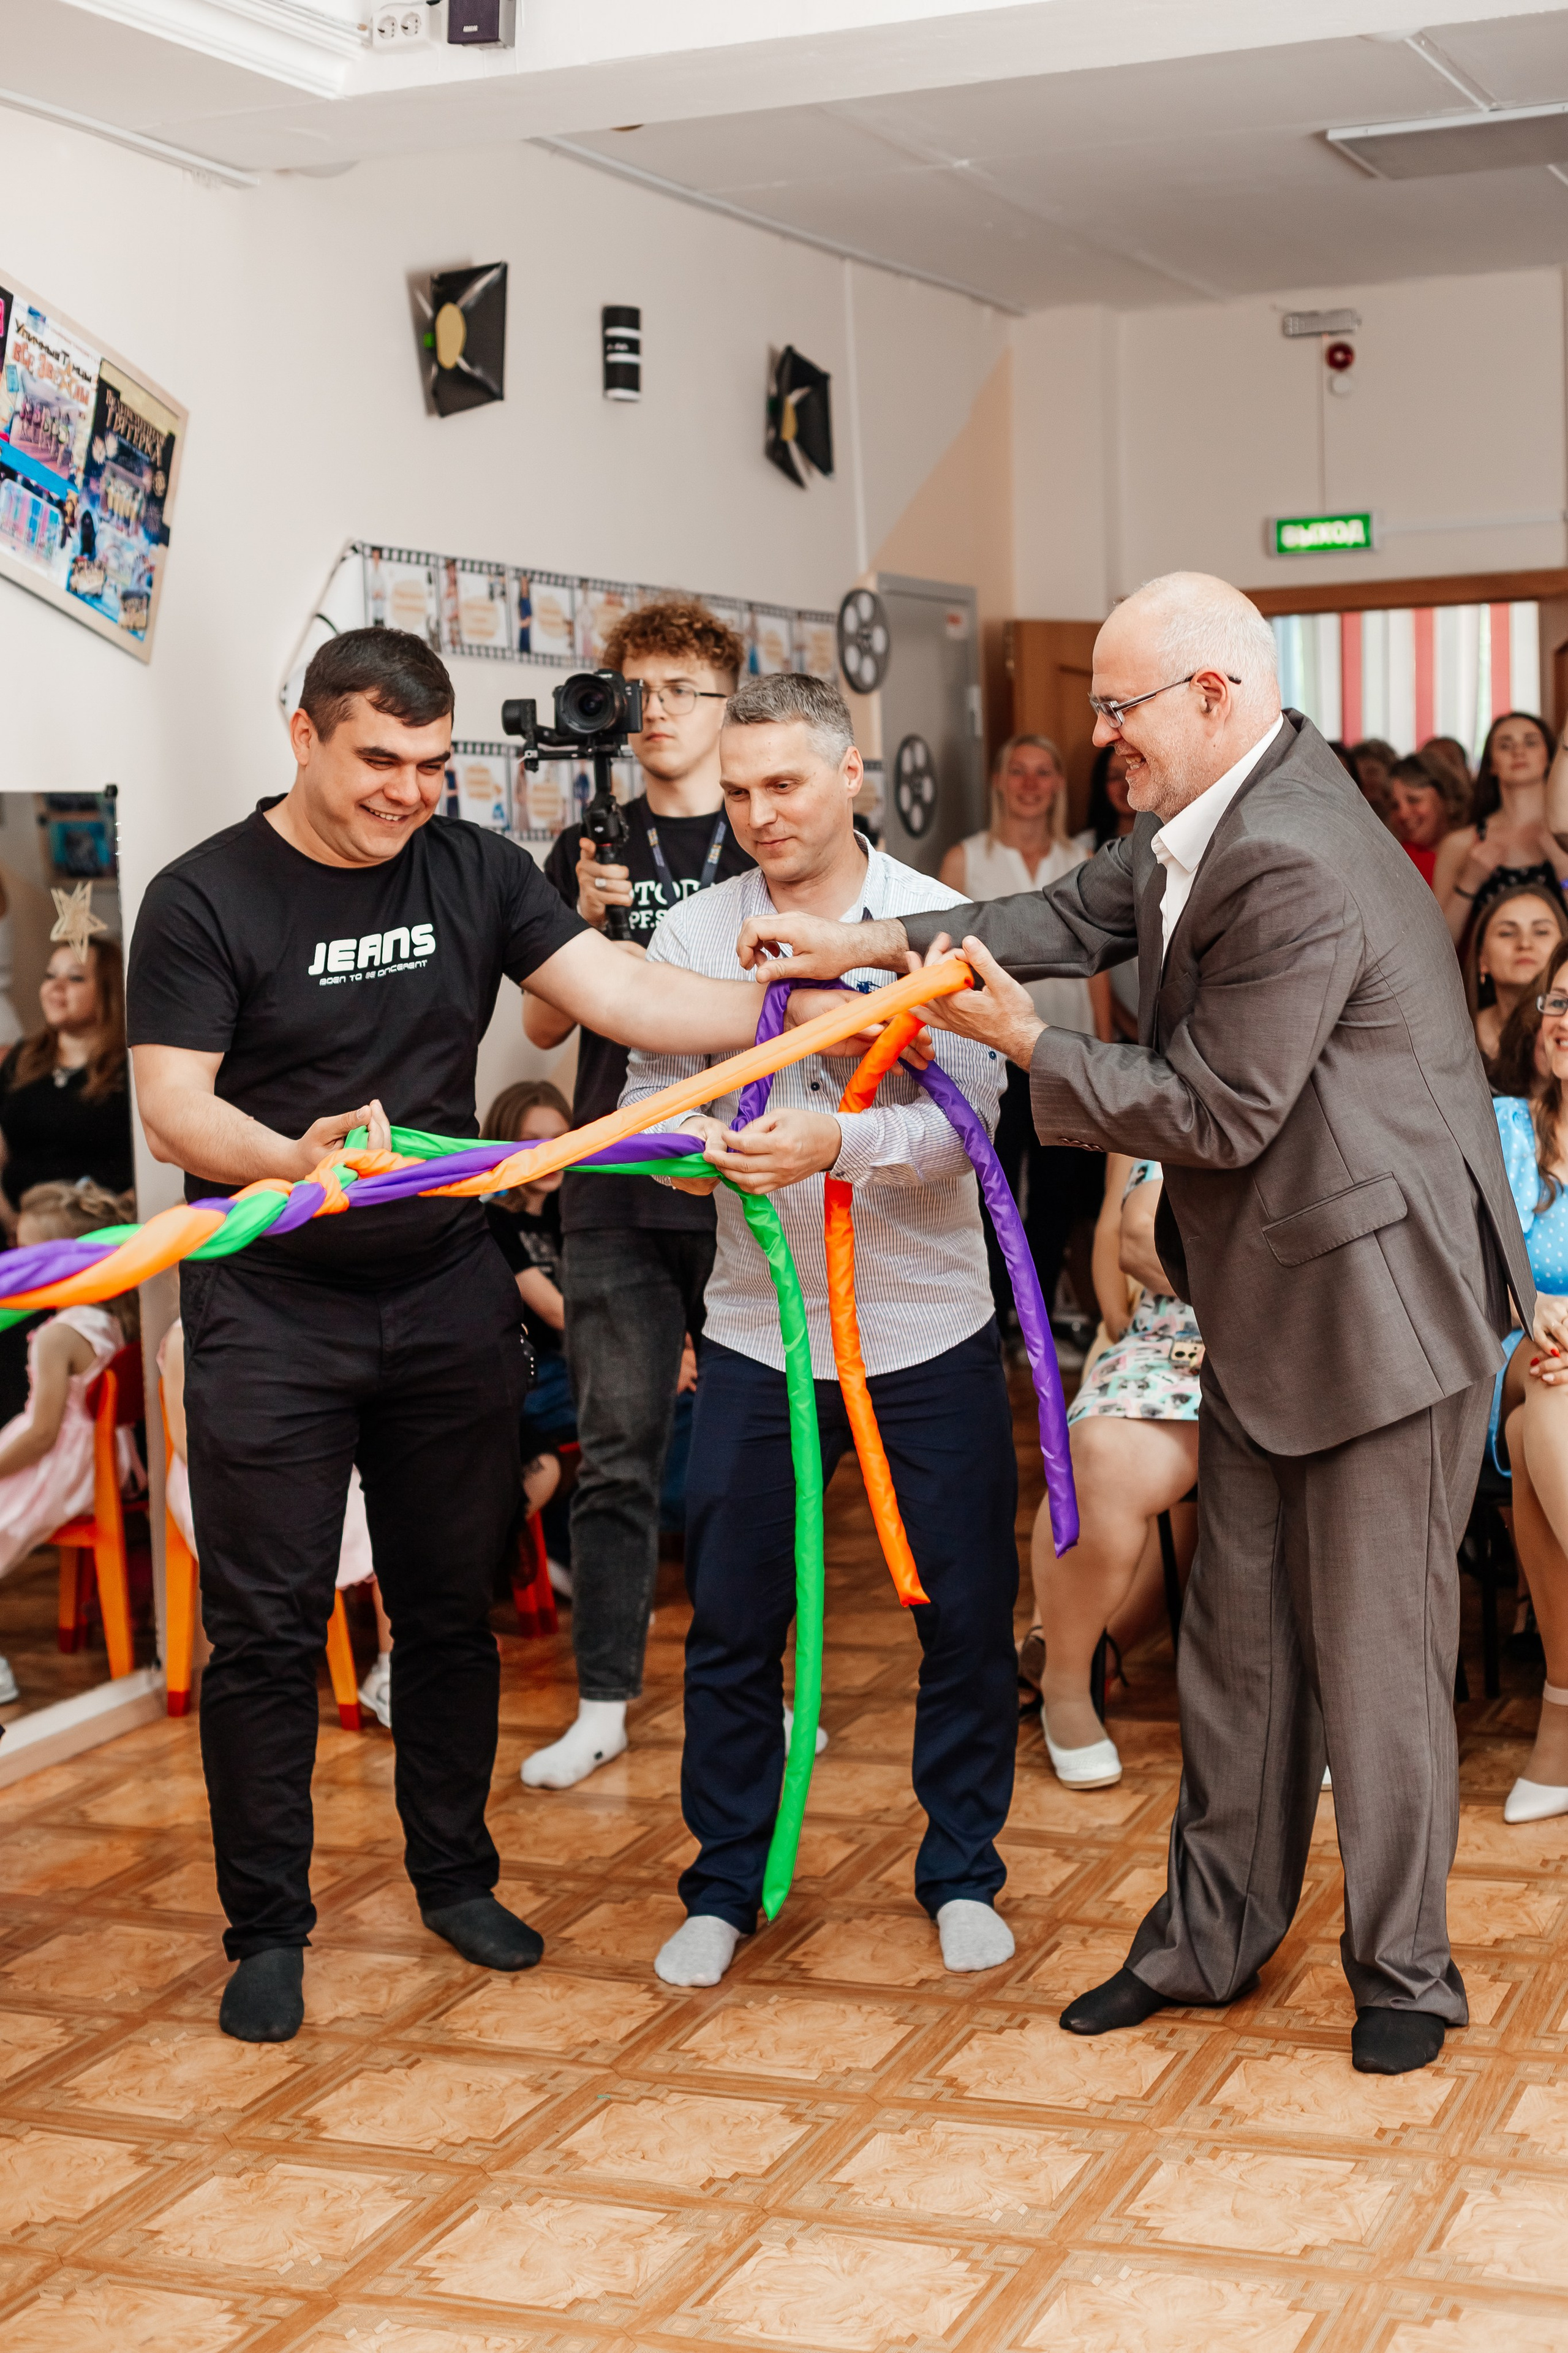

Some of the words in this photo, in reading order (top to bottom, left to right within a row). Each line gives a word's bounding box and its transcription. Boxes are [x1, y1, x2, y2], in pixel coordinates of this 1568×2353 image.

[38, 353, 90, 406] ЗВЕДЫ
[61, 349, 92, 383] Тнцы
[308, 923, 436, 976] JEANS
[349, 973, 363, 982] TO
